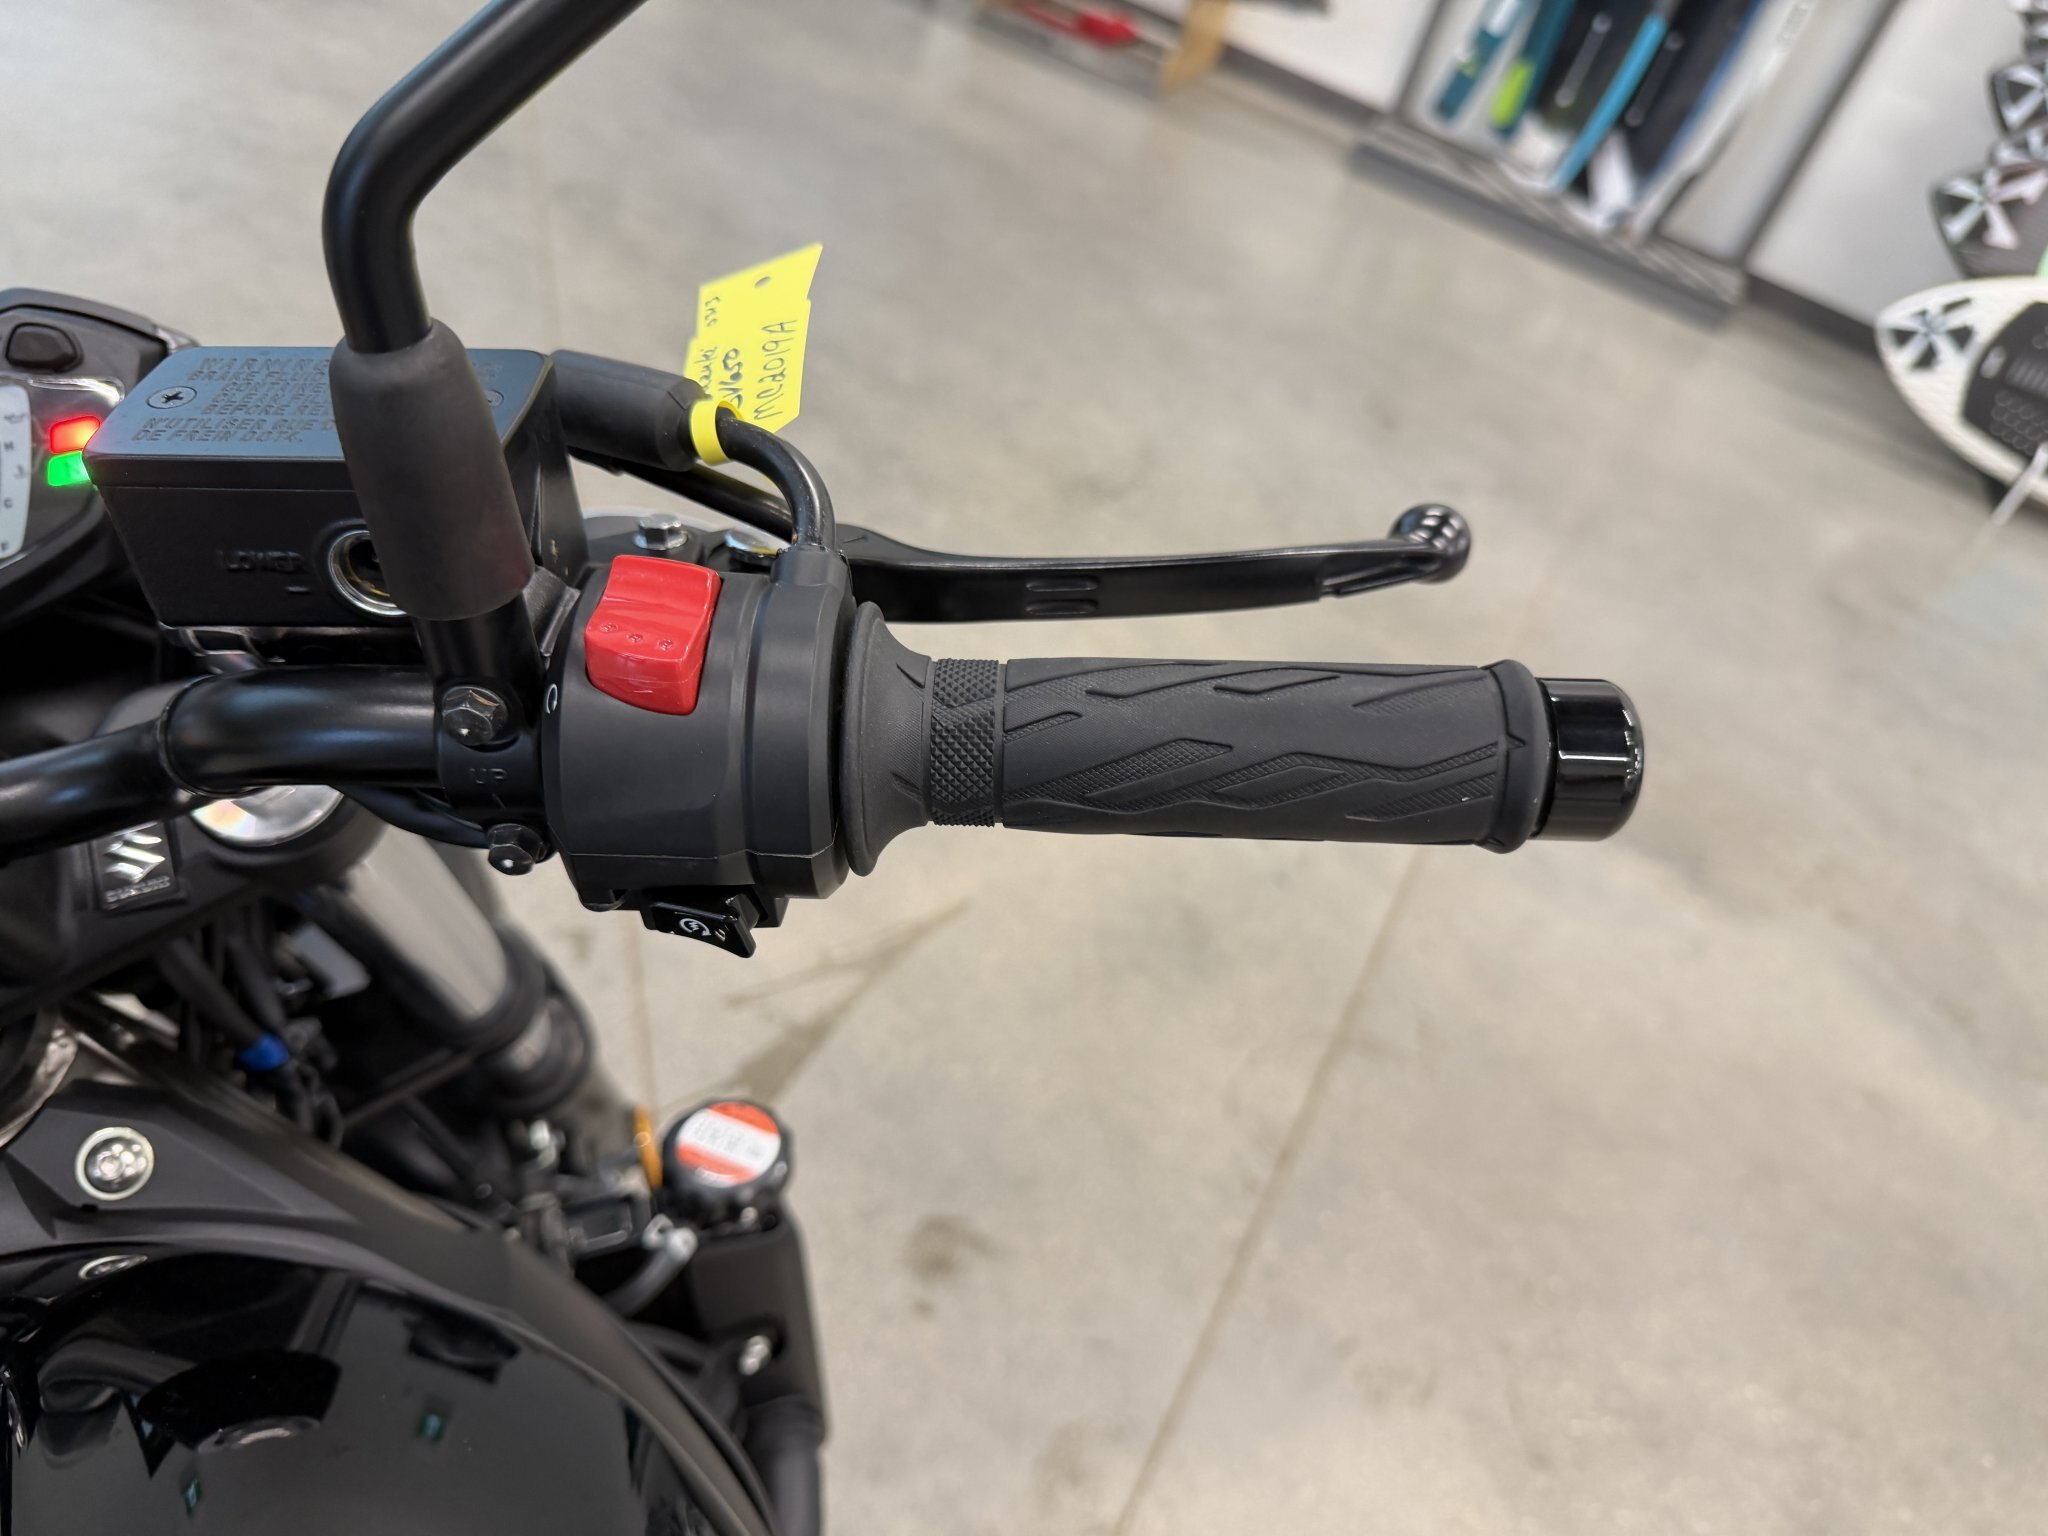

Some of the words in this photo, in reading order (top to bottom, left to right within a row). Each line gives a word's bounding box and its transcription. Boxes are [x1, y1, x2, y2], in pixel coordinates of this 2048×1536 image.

[201, 357, 329, 371] WARNING
[753, 319, 798, 420] MC2019A
[188, 371, 260, 382] BRAKE
[220, 381, 327, 393] CONTAINE
[212, 393, 284, 405] CLEAN
[200, 404, 291, 415] BEFORE
[143, 418, 267, 430] N'UTILISER
[271, 418, 319, 430] QUE
[131, 429, 167, 441] DE
[167, 430, 238, 442] FREIN
[468, 767, 507, 786] UP
